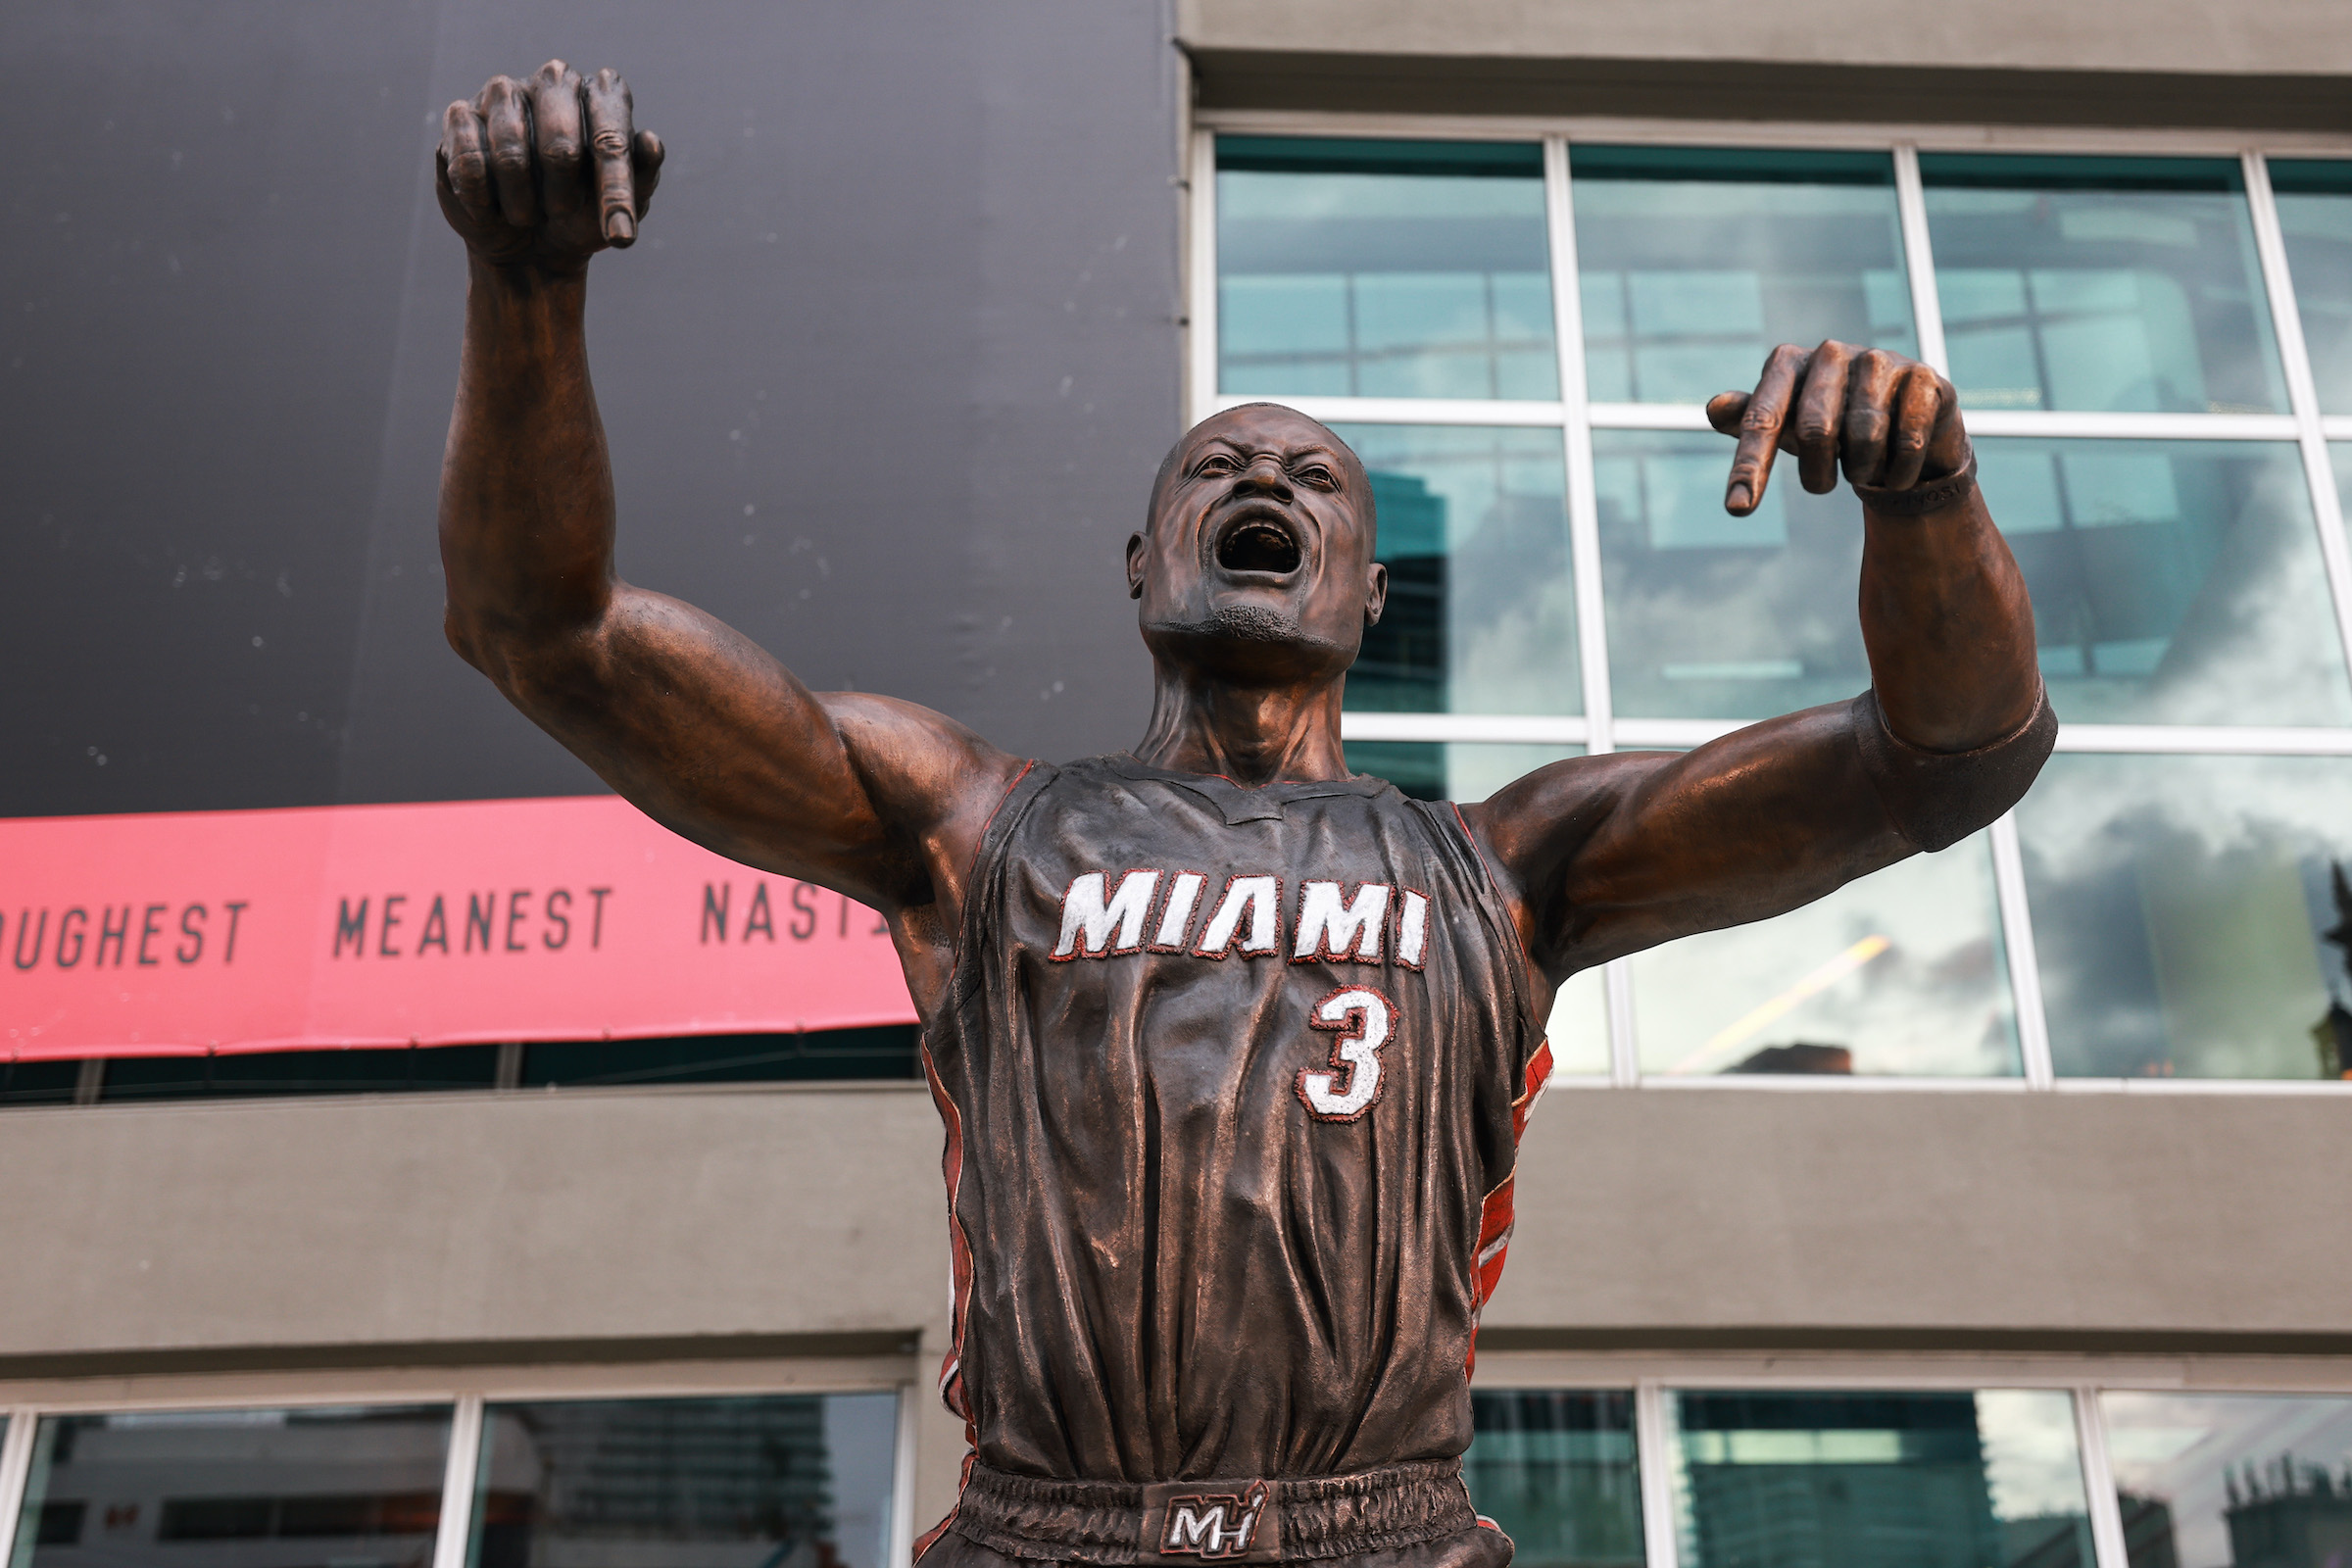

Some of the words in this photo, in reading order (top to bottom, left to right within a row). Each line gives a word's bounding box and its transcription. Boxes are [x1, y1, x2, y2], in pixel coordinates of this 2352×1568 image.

[333, 888, 612, 958] MEANEST
[1048, 868, 1433, 973] MIAMI
[1294, 984, 1401, 1125] 3
